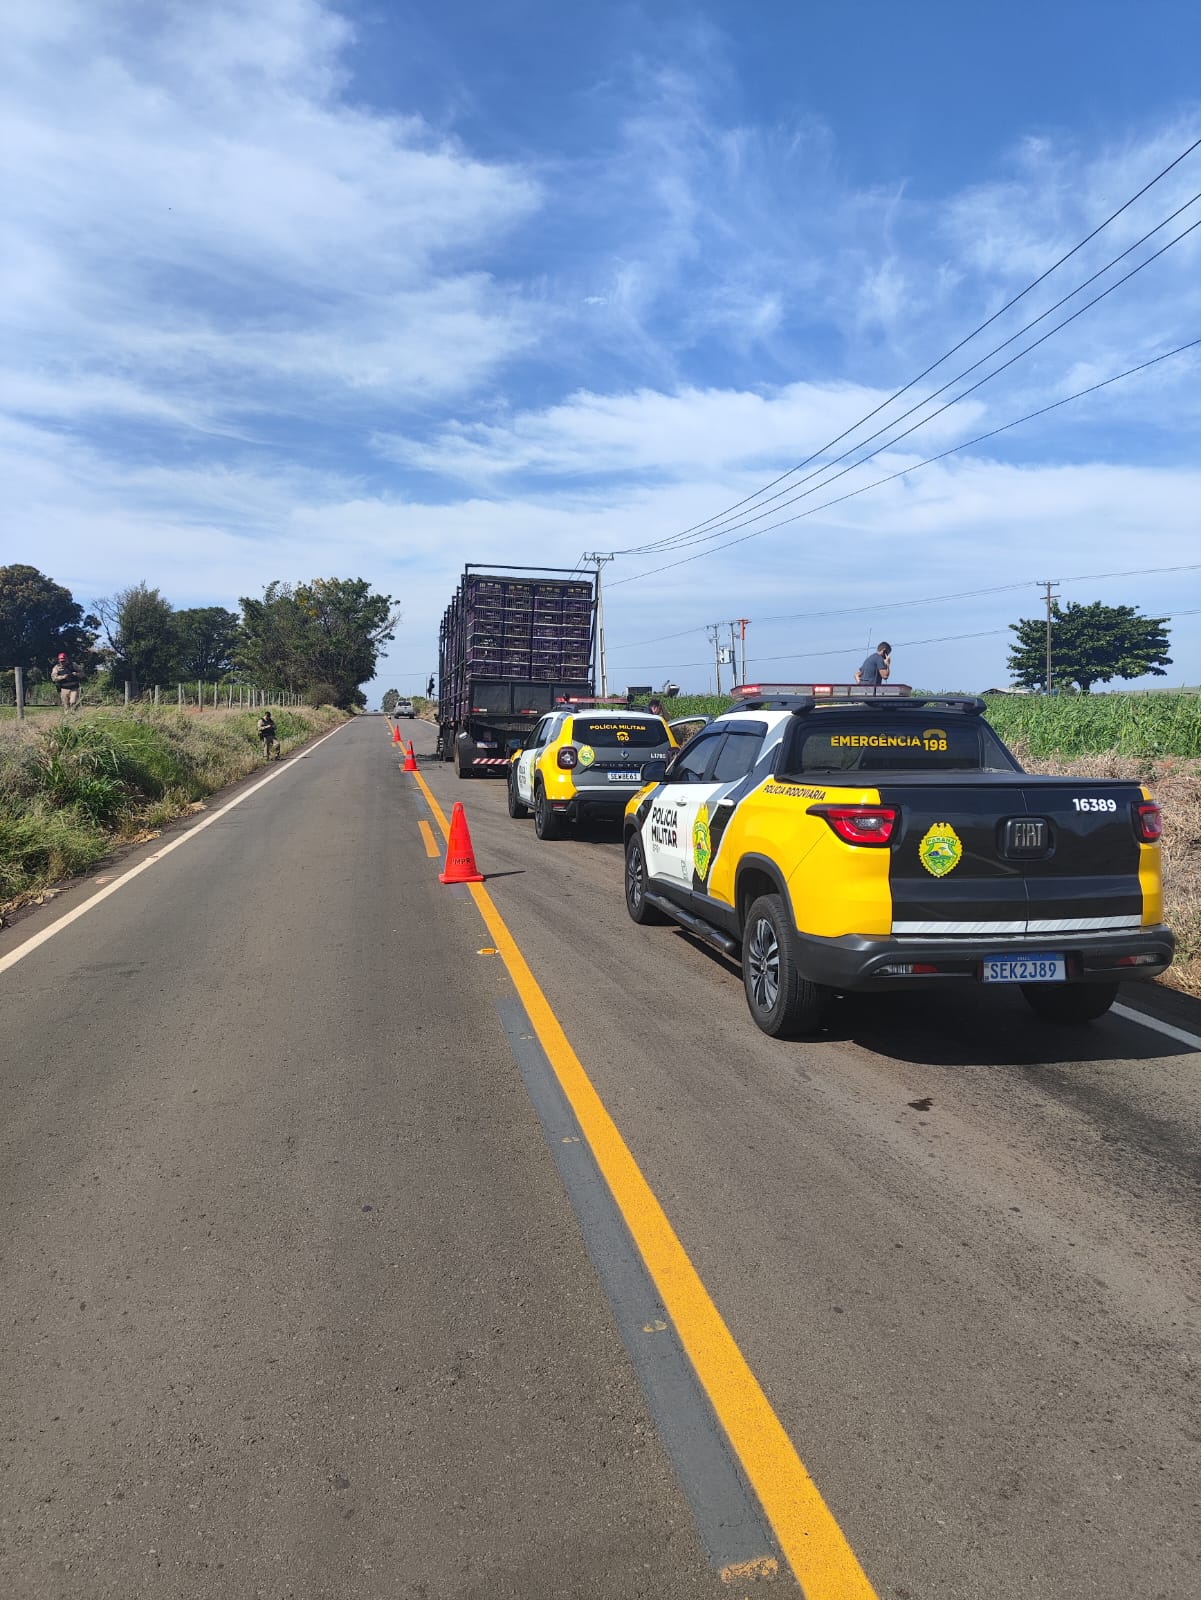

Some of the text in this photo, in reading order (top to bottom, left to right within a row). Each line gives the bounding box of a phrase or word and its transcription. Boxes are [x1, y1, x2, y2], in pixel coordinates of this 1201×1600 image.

[589, 723, 618, 731] POLÍCIA
[830, 732, 948, 751] EMERGÊNCIA 198
[1072, 798, 1117, 812] 16389
[651, 806, 678, 828] POLÍCIA
[651, 825, 678, 848] MILITAR
[1015, 823, 1044, 847] FIAT
[990, 962, 1057, 979] SEK2J89
